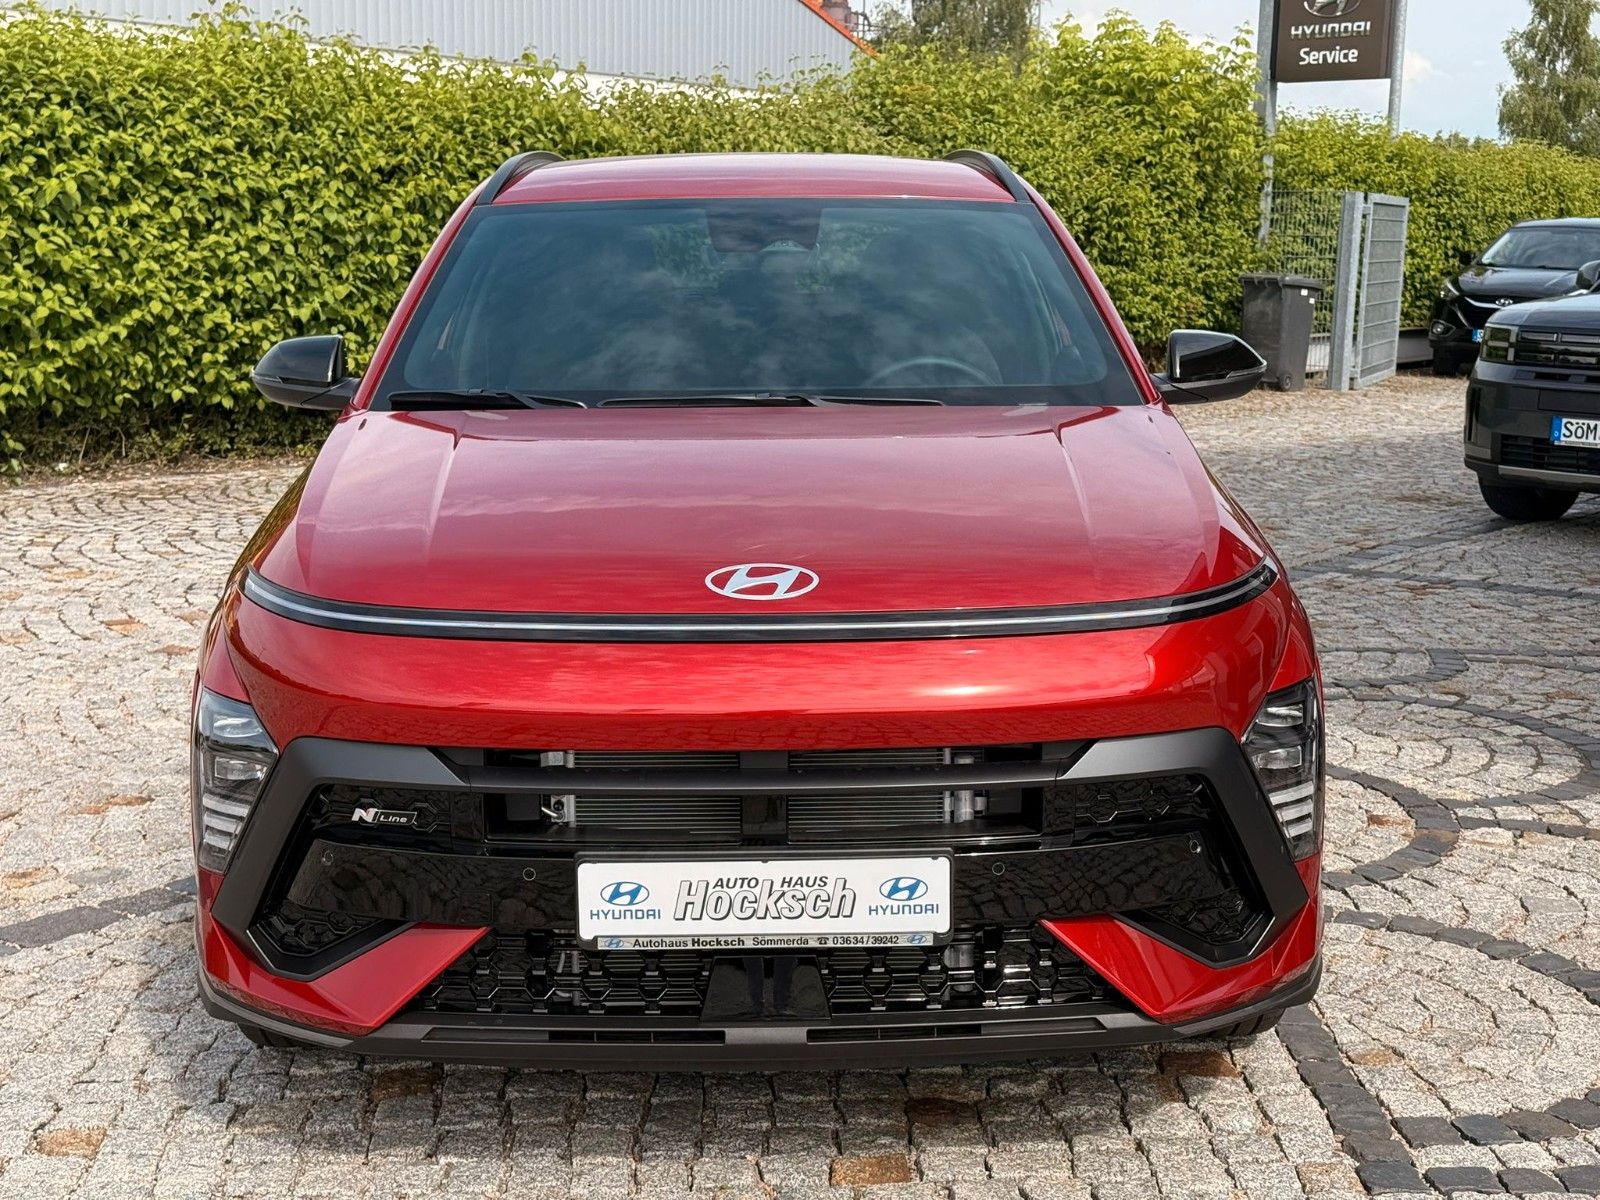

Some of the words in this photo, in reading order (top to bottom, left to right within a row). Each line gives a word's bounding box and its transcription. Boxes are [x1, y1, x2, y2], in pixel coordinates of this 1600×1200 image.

[1291, 21, 1371, 38] HYUNDAI
[1299, 46, 1359, 65] Service
[713, 877, 759, 889] AUTO
[780, 876, 828, 888] HAUS
[673, 877, 857, 921] Hocksch
[590, 909, 661, 920] HYUNDAI
[868, 903, 939, 916] HYUNDAI
[632, 938, 688, 948] Autohaus
[691, 937, 745, 947] Hocksch
[752, 935, 809, 946] Sömmerda
